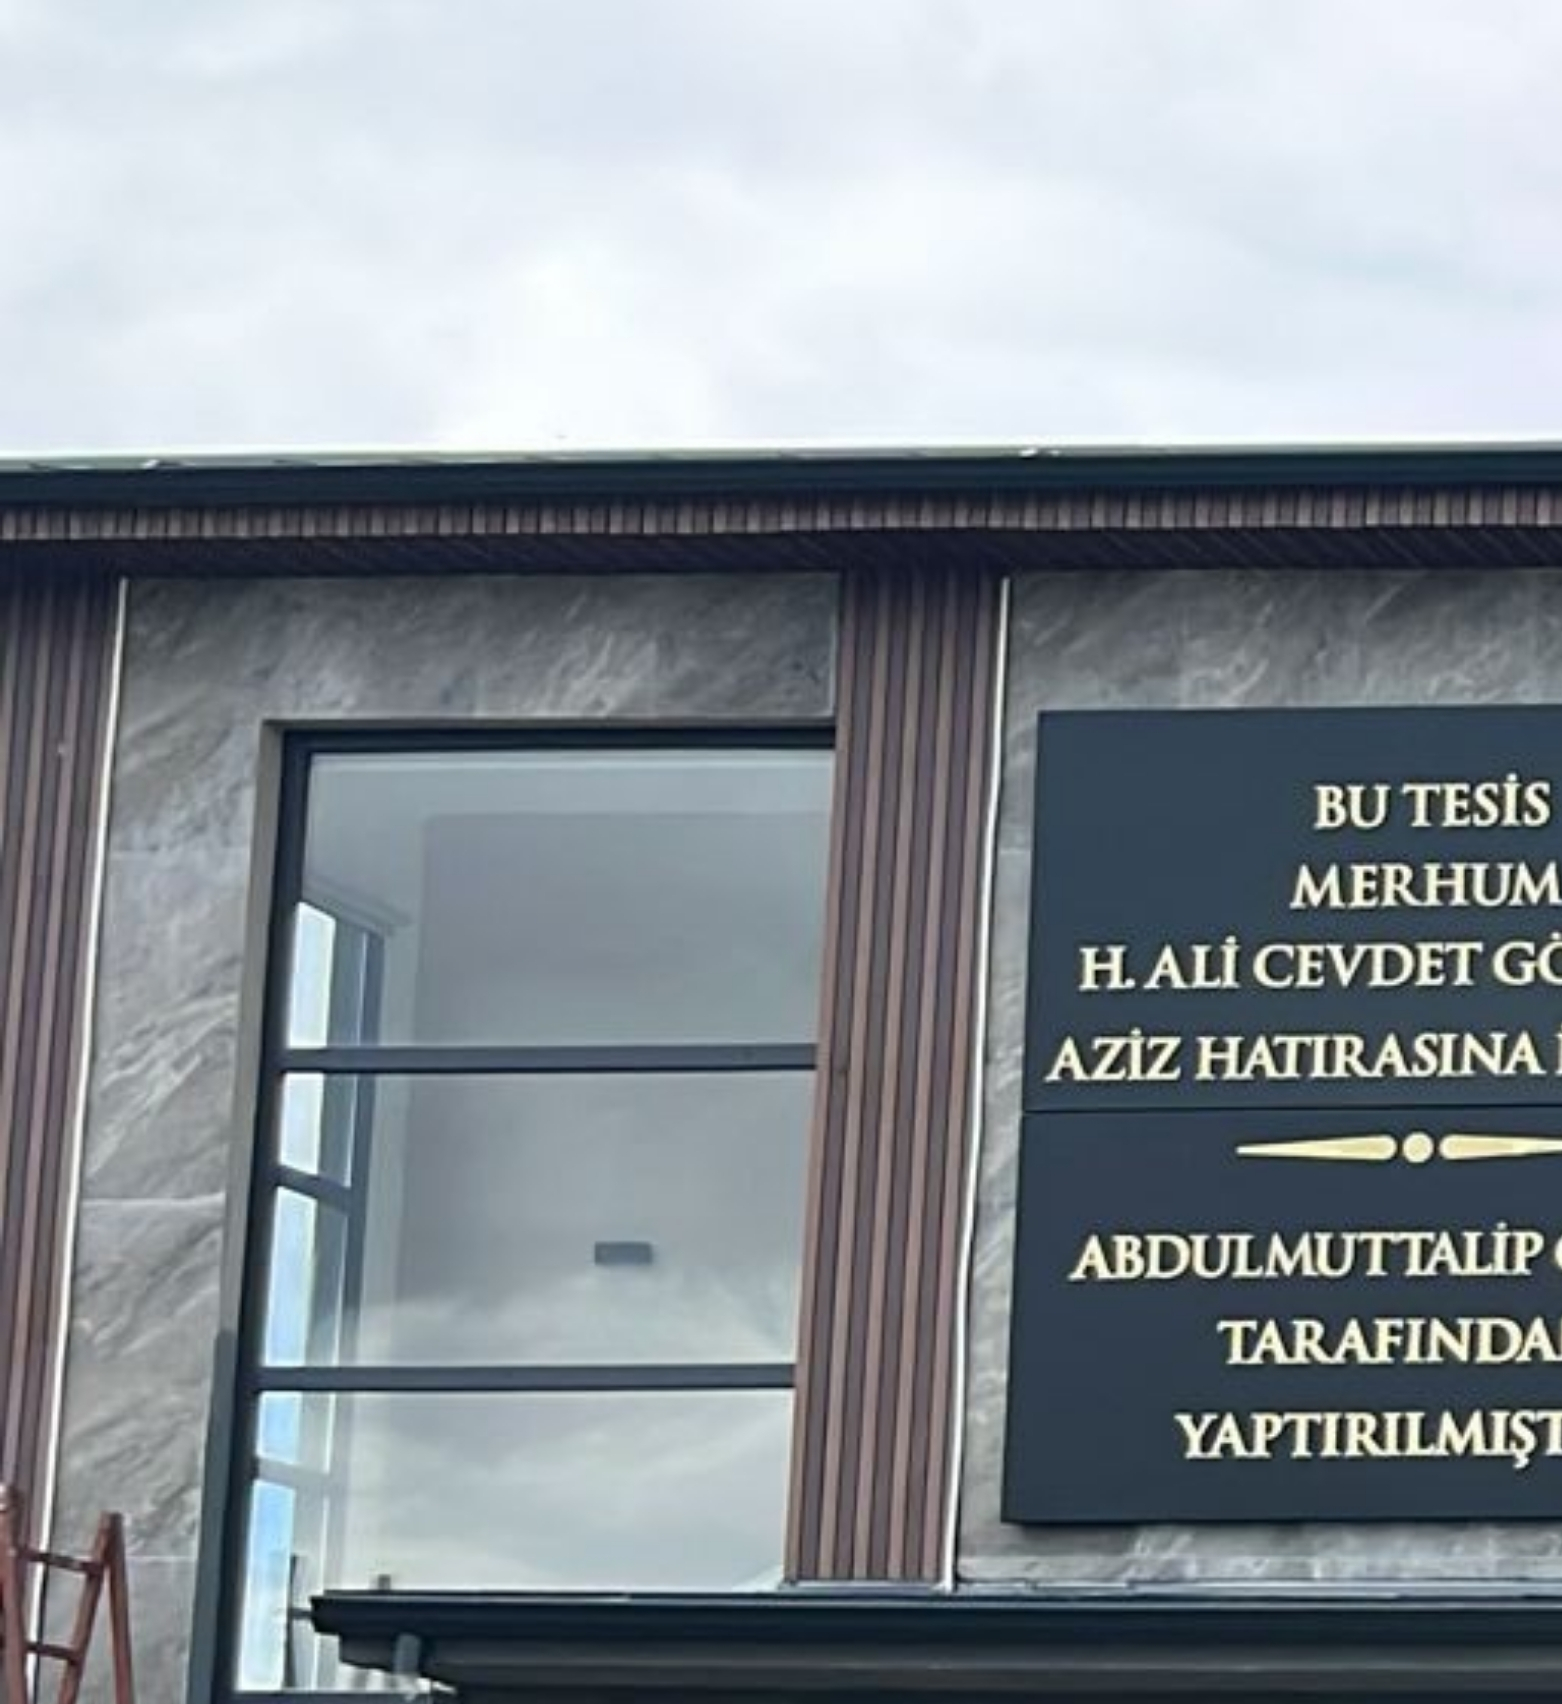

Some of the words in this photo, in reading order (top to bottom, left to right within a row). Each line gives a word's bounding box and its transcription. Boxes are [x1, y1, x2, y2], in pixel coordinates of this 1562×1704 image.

[1313, 784, 1391, 829] BU
[1401, 773, 1551, 828] TESİS
[1079, 945, 1136, 991] H.
[1143, 935, 1240, 990] ALİ
[1252, 941, 1485, 988] CEVDET
[1045, 1027, 1182, 1082] AZİZ
[1195, 1031, 1544, 1080] HATIRASINA
[1068, 1222, 1545, 1282] ABDULMUTTALİP
